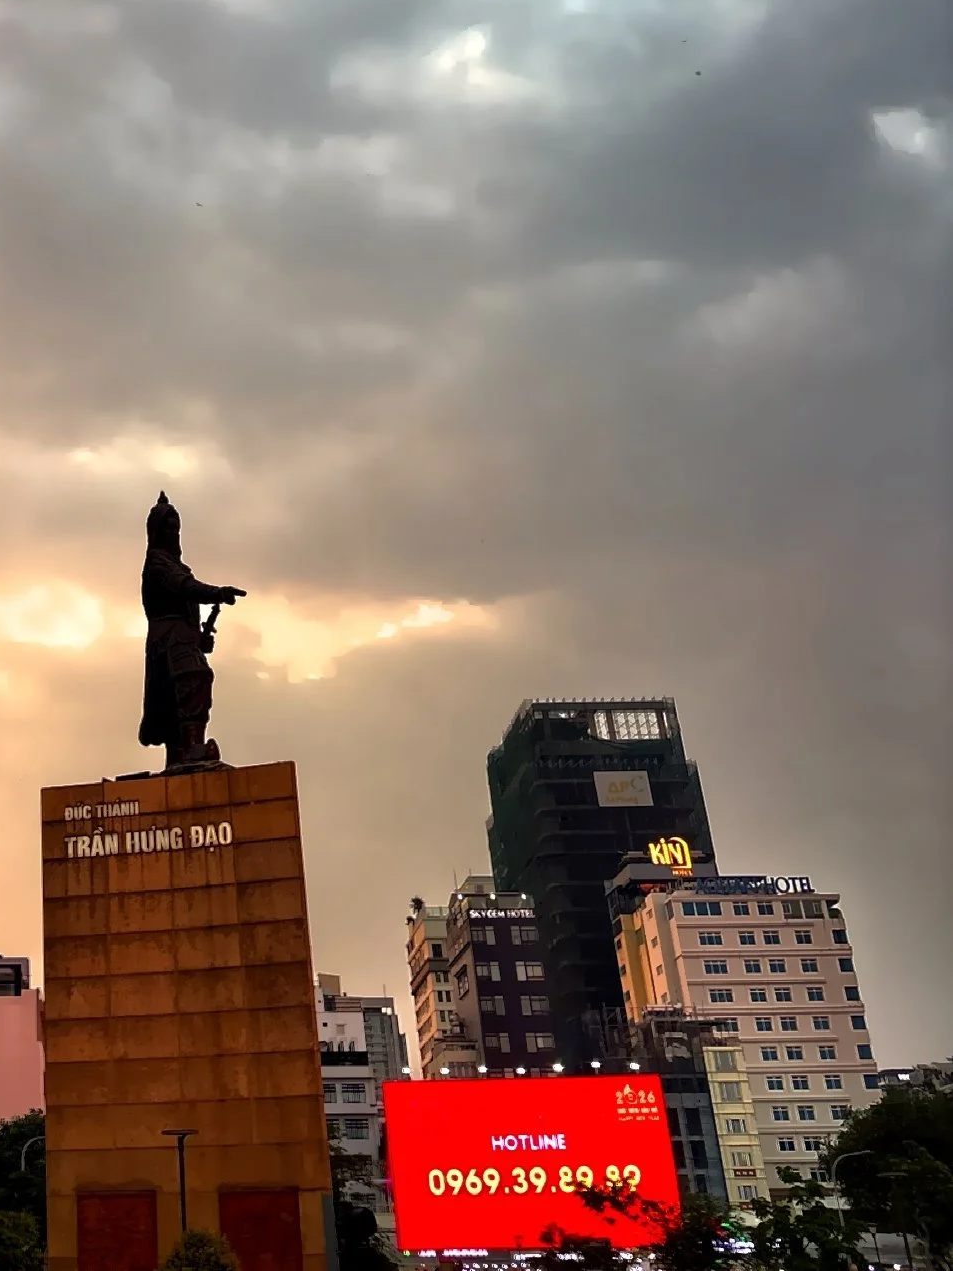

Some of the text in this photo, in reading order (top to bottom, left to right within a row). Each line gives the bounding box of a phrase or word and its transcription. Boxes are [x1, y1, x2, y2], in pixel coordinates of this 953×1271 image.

[95, 799, 140, 818] THÁNH
[64, 821, 233, 858] TRẦN HƯNG ĐẠO
[764, 876, 816, 894] HOTEL
[506, 909, 536, 919] HOTEL
[491, 1134, 566, 1151] HOTLINE
[428, 1164, 642, 1196] 0969.39.8989
